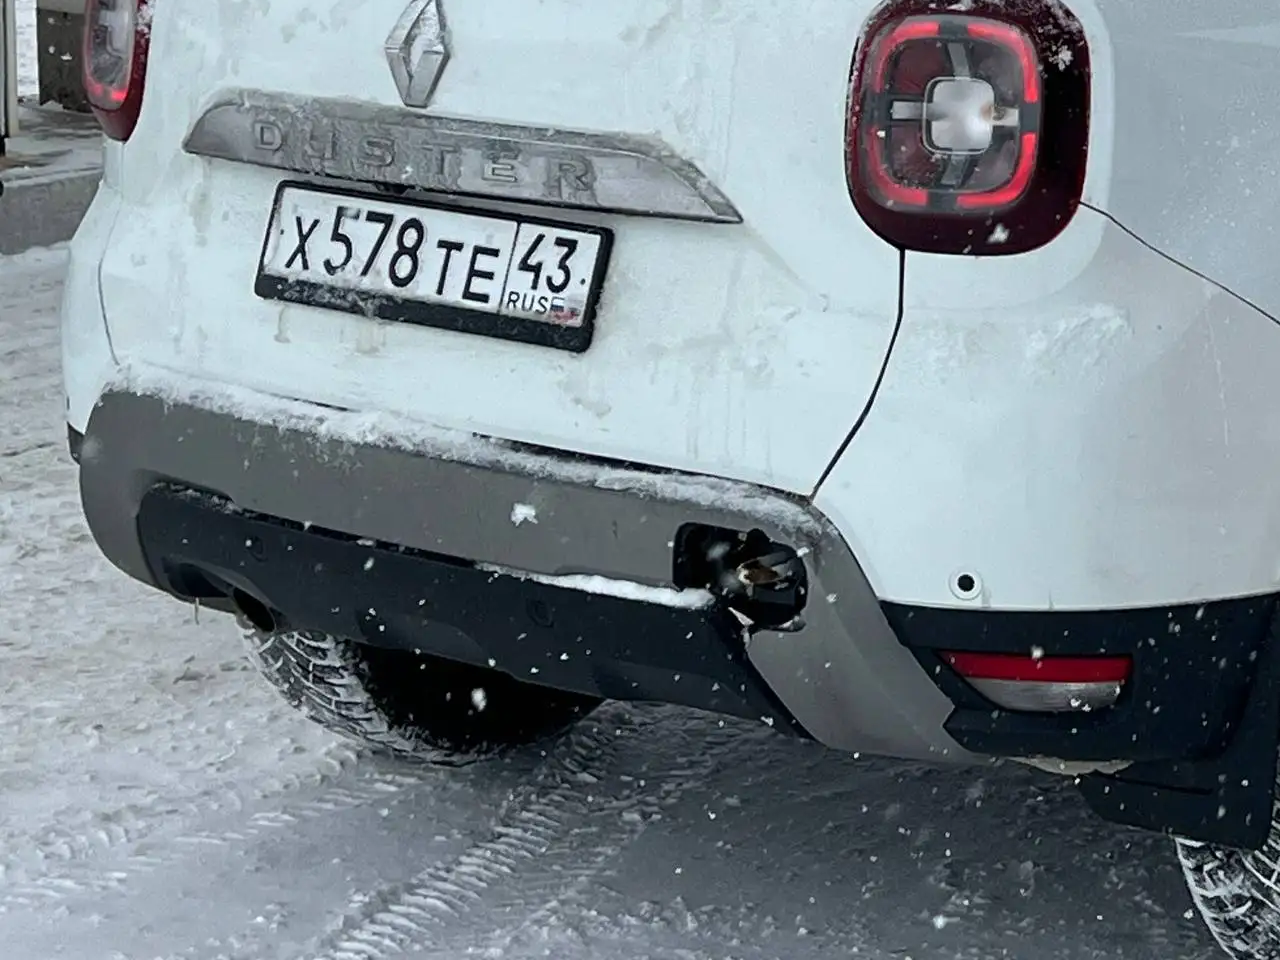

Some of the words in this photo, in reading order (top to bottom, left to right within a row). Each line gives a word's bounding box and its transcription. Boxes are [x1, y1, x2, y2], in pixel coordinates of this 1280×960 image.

[253, 120, 592, 193] DUSTER
[516, 232, 580, 294] 43
[505, 290, 549, 314] RUS
